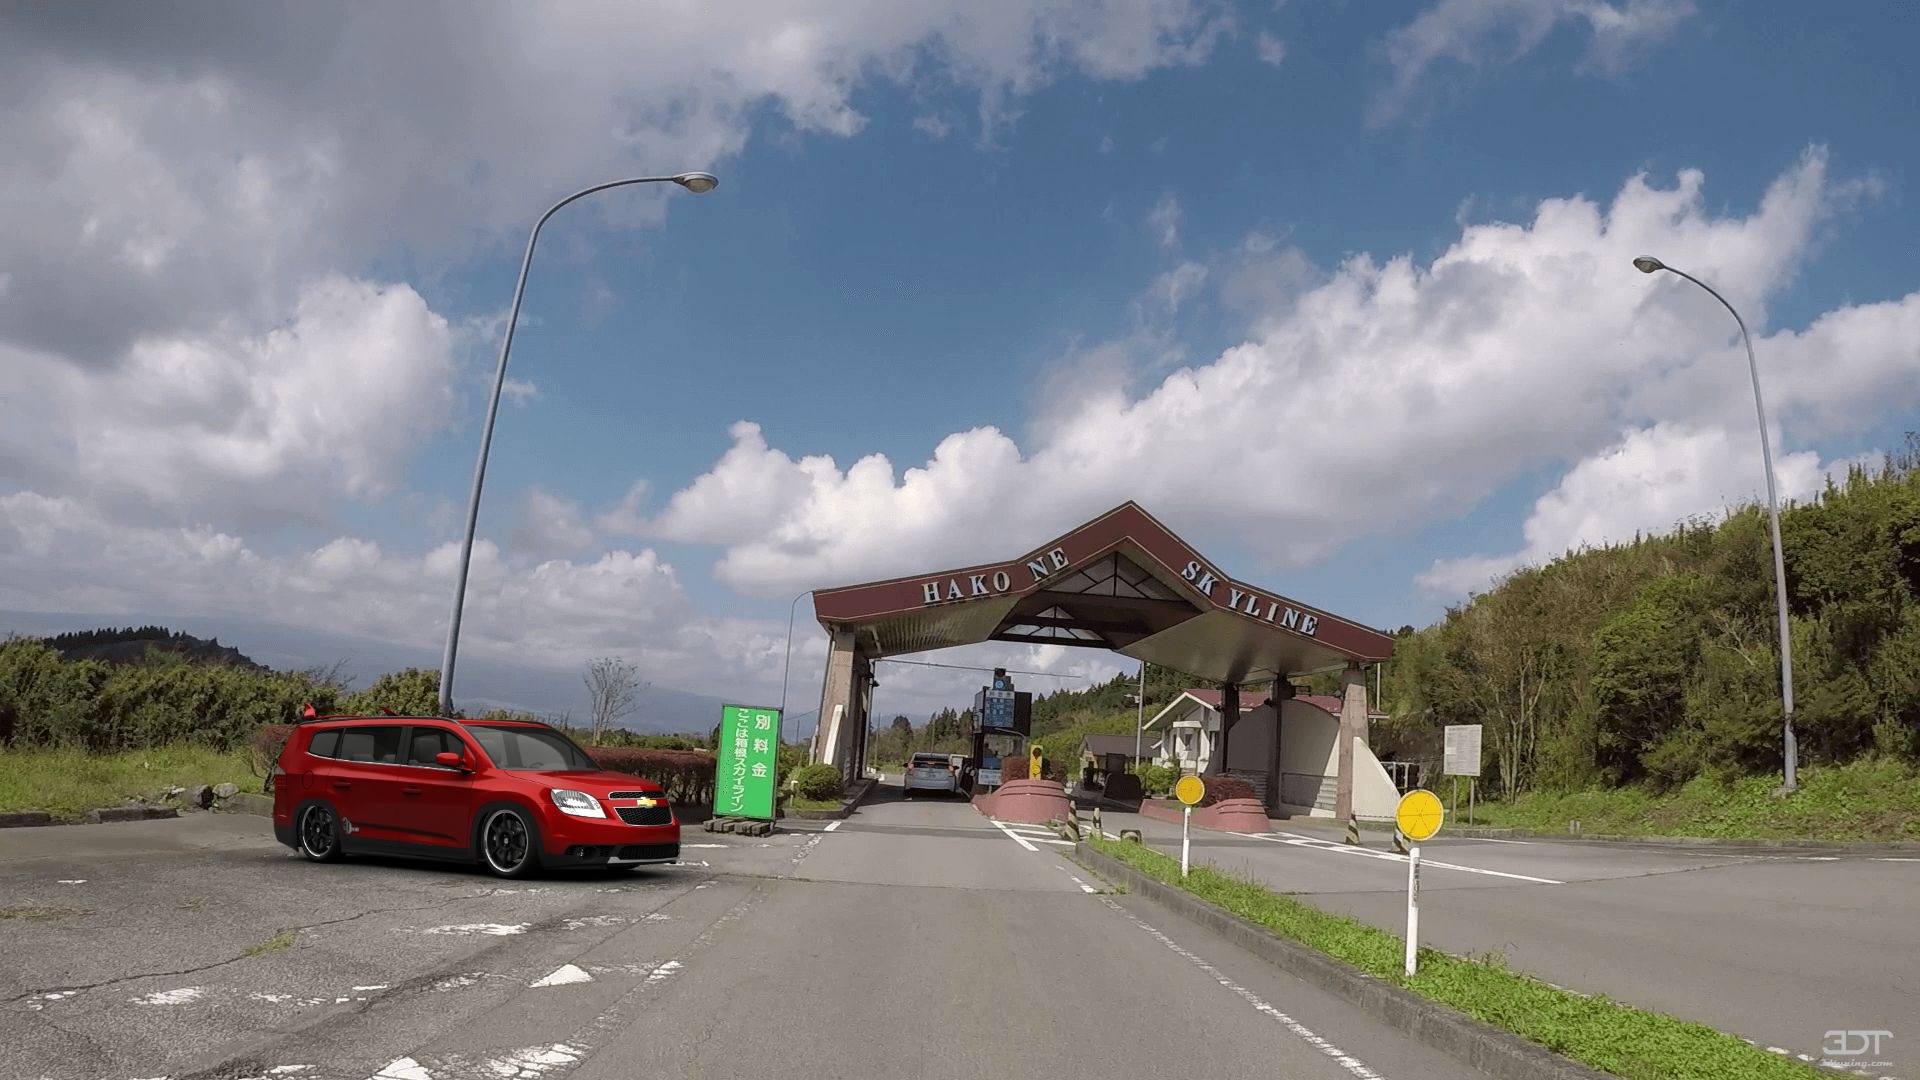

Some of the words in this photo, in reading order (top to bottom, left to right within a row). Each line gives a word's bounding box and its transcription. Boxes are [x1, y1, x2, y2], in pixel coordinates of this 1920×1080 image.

[731, 708, 750, 812] ここは箱根スカイライン
